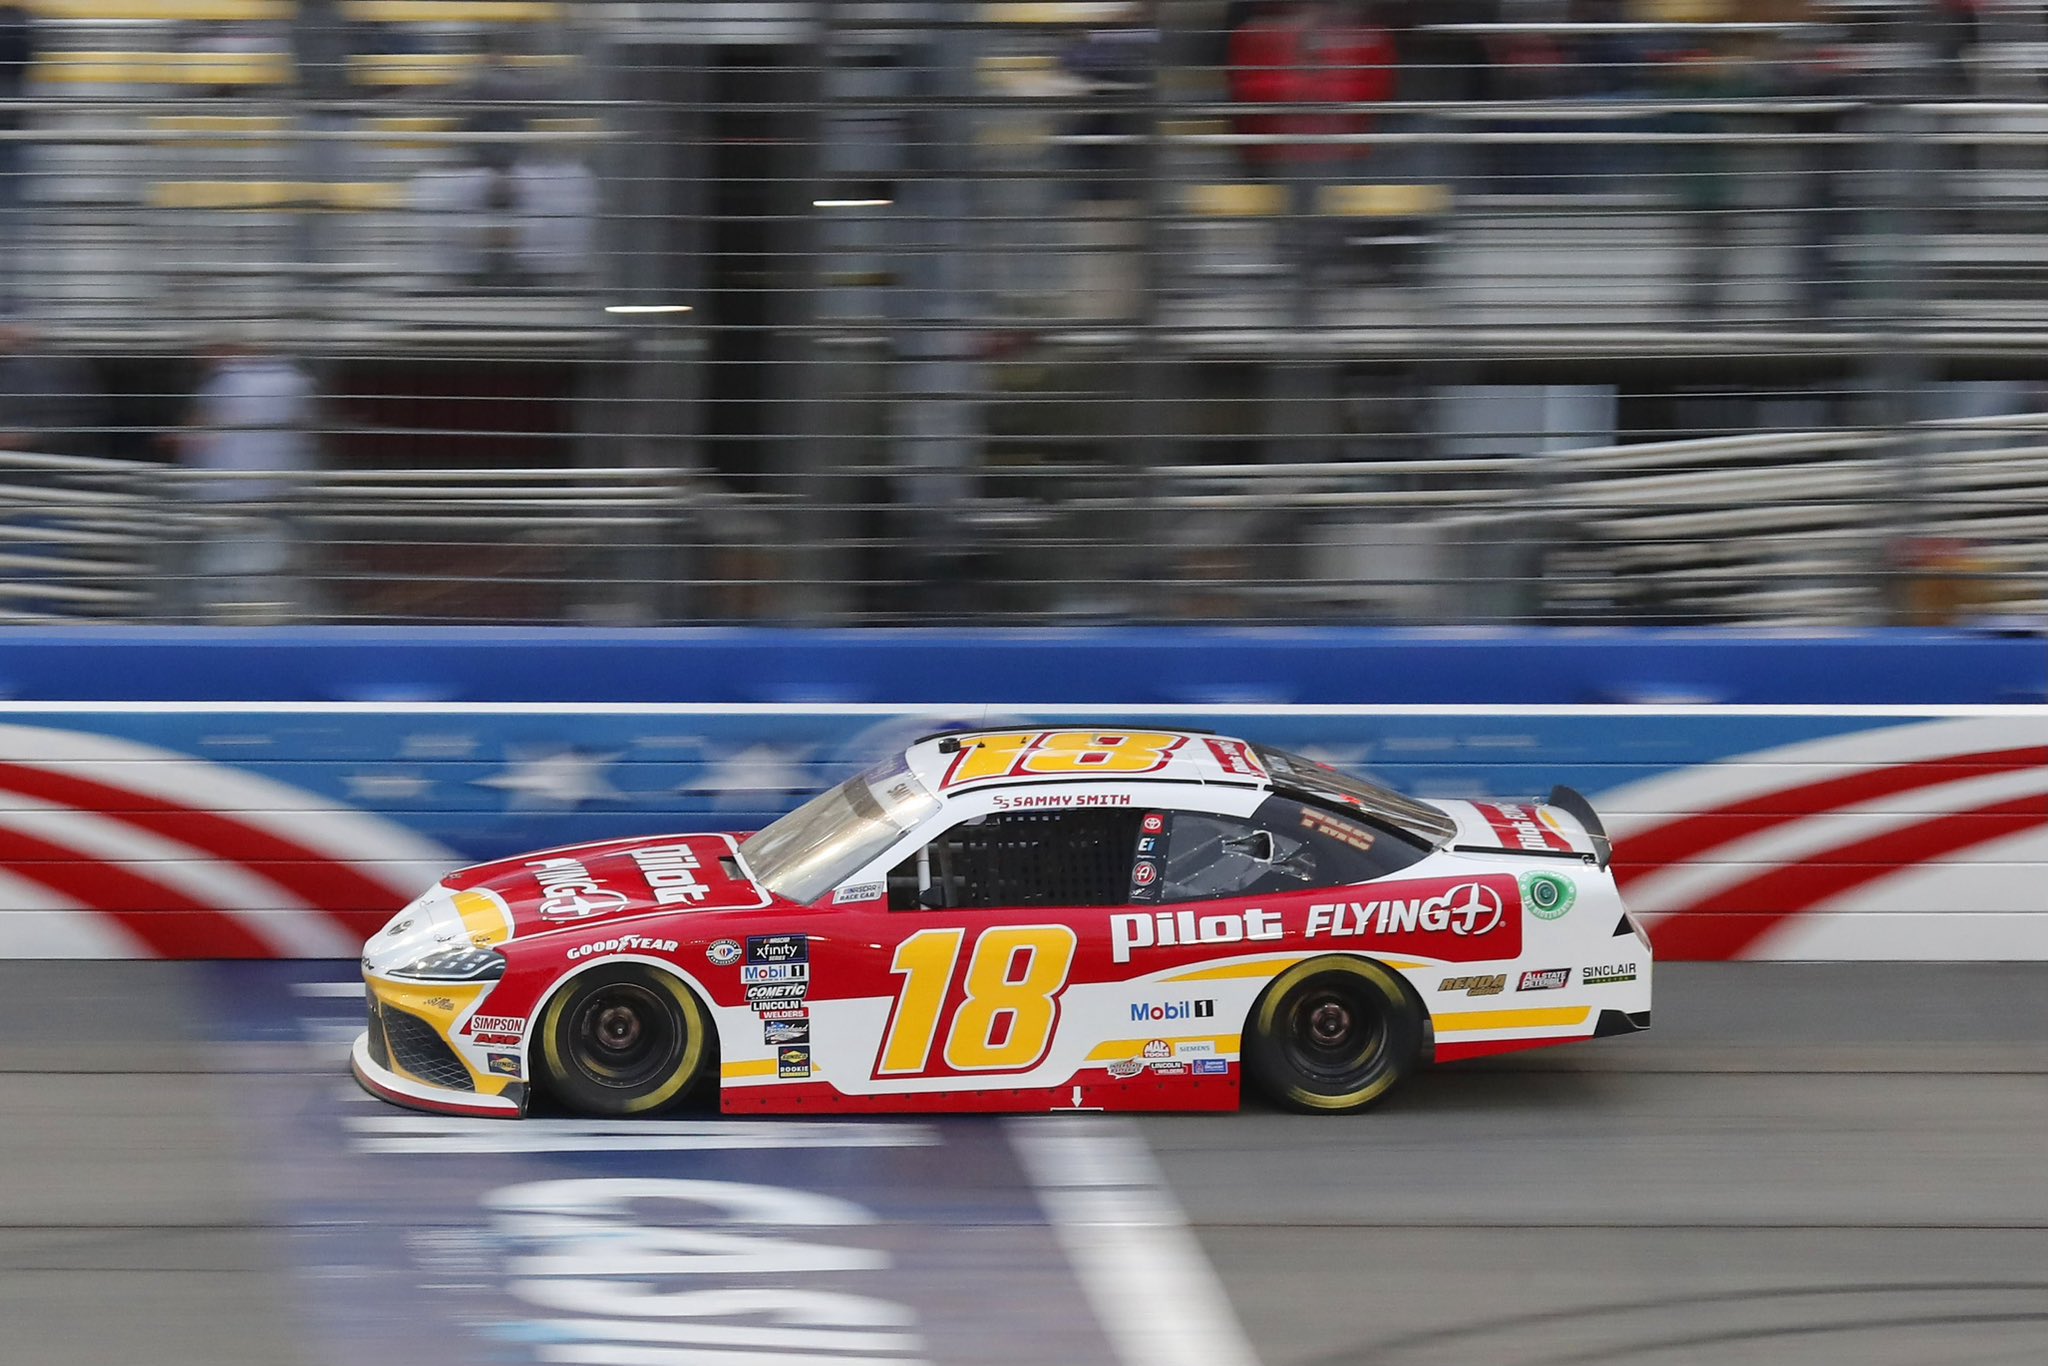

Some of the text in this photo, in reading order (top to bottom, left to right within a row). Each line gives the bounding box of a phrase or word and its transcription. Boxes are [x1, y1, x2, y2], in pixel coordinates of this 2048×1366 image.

[940, 731, 1189, 788] 18
[1013, 796, 1072, 807] SAMMY
[1076, 794, 1131, 805] SMITH
[606, 844, 710, 905] Pilot
[1305, 896, 1450, 938] FLYING
[1110, 908, 1283, 963] Pilot
[567, 935, 679, 960] GOODYEAR
[756, 943, 798, 959] xfinity
[745, 965, 787, 979] Mobil
[1582, 963, 1636, 977] SINCLAIR
[747, 983, 806, 998] COMETIC
[1440, 974, 1507, 991] RENDA
[753, 1001, 799, 1011] LINCOLN
[874, 924, 1077, 1076] 18
[763, 1010, 804, 1019] WELDERS
[1131, 1000, 1210, 1021] Mobil 1
[473, 1017, 523, 1031] SIMPSON
